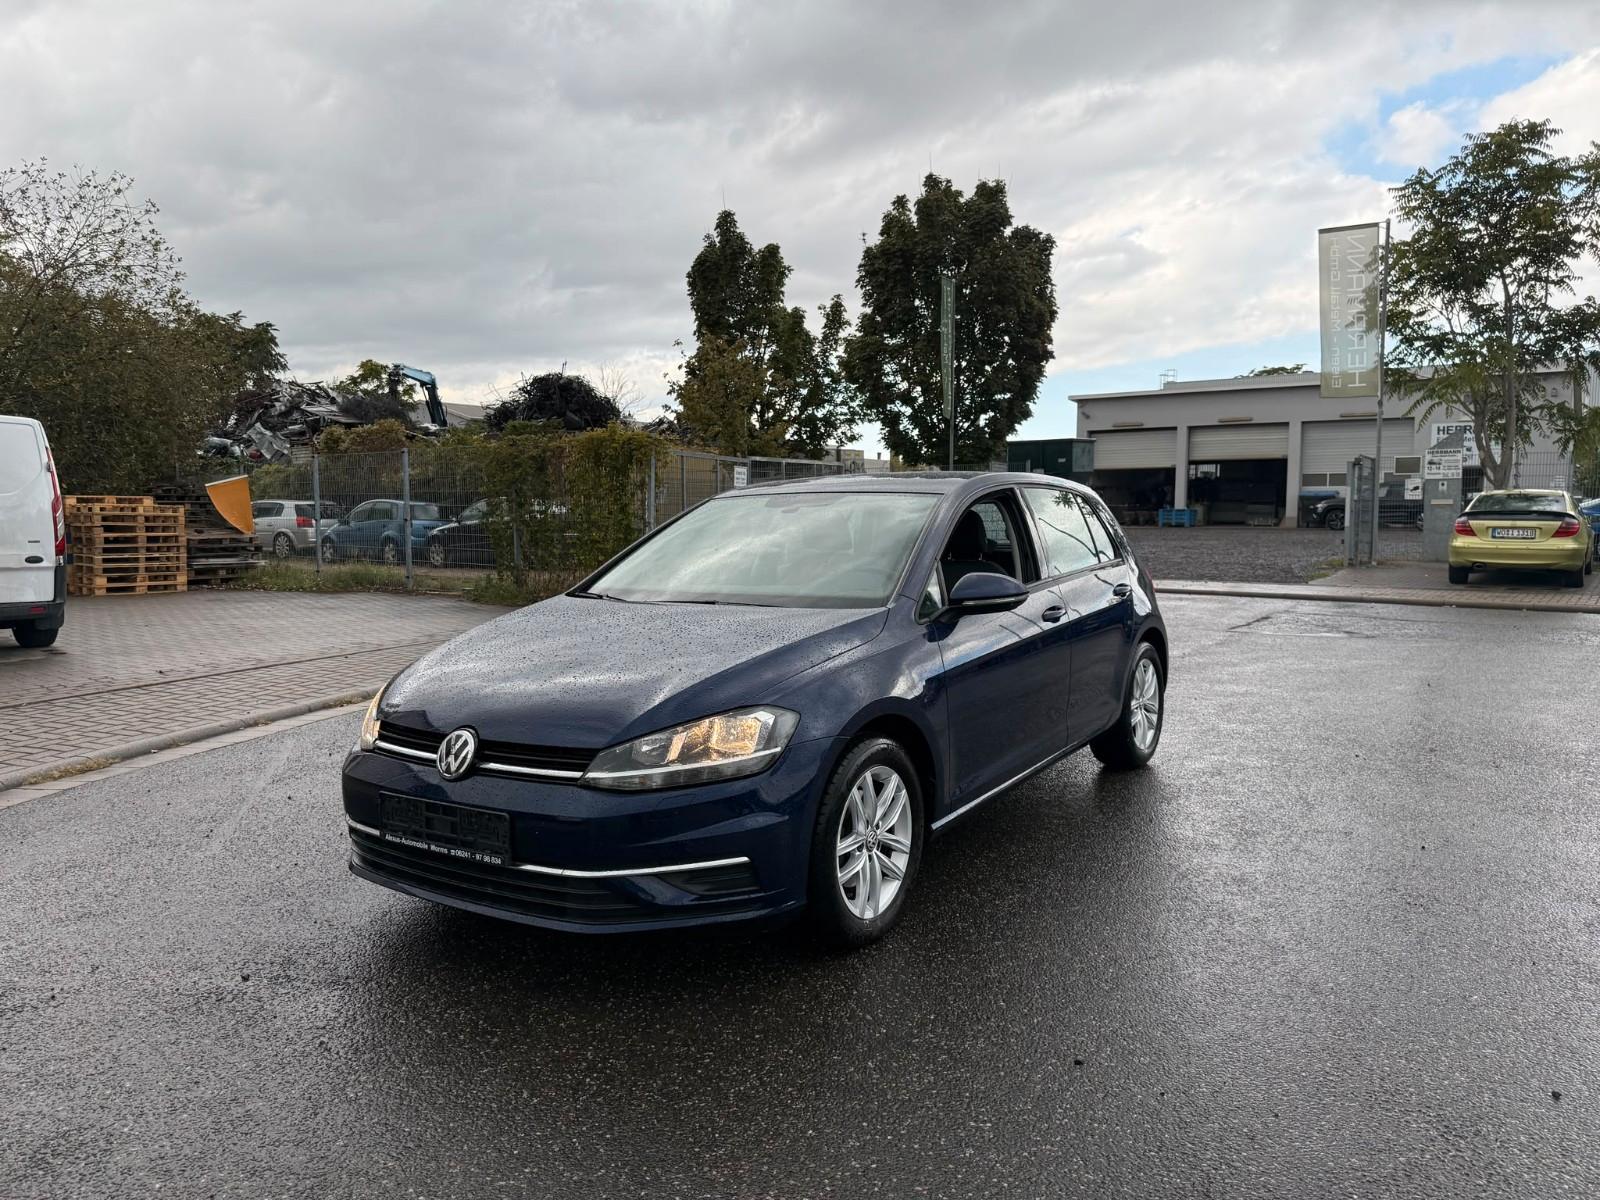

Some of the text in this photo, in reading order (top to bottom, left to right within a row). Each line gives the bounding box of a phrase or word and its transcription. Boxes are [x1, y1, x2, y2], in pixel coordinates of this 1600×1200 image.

[1437, 425, 1473, 435] HERR
[437, 730, 475, 777] VW
[430, 844, 448, 854] Worms
